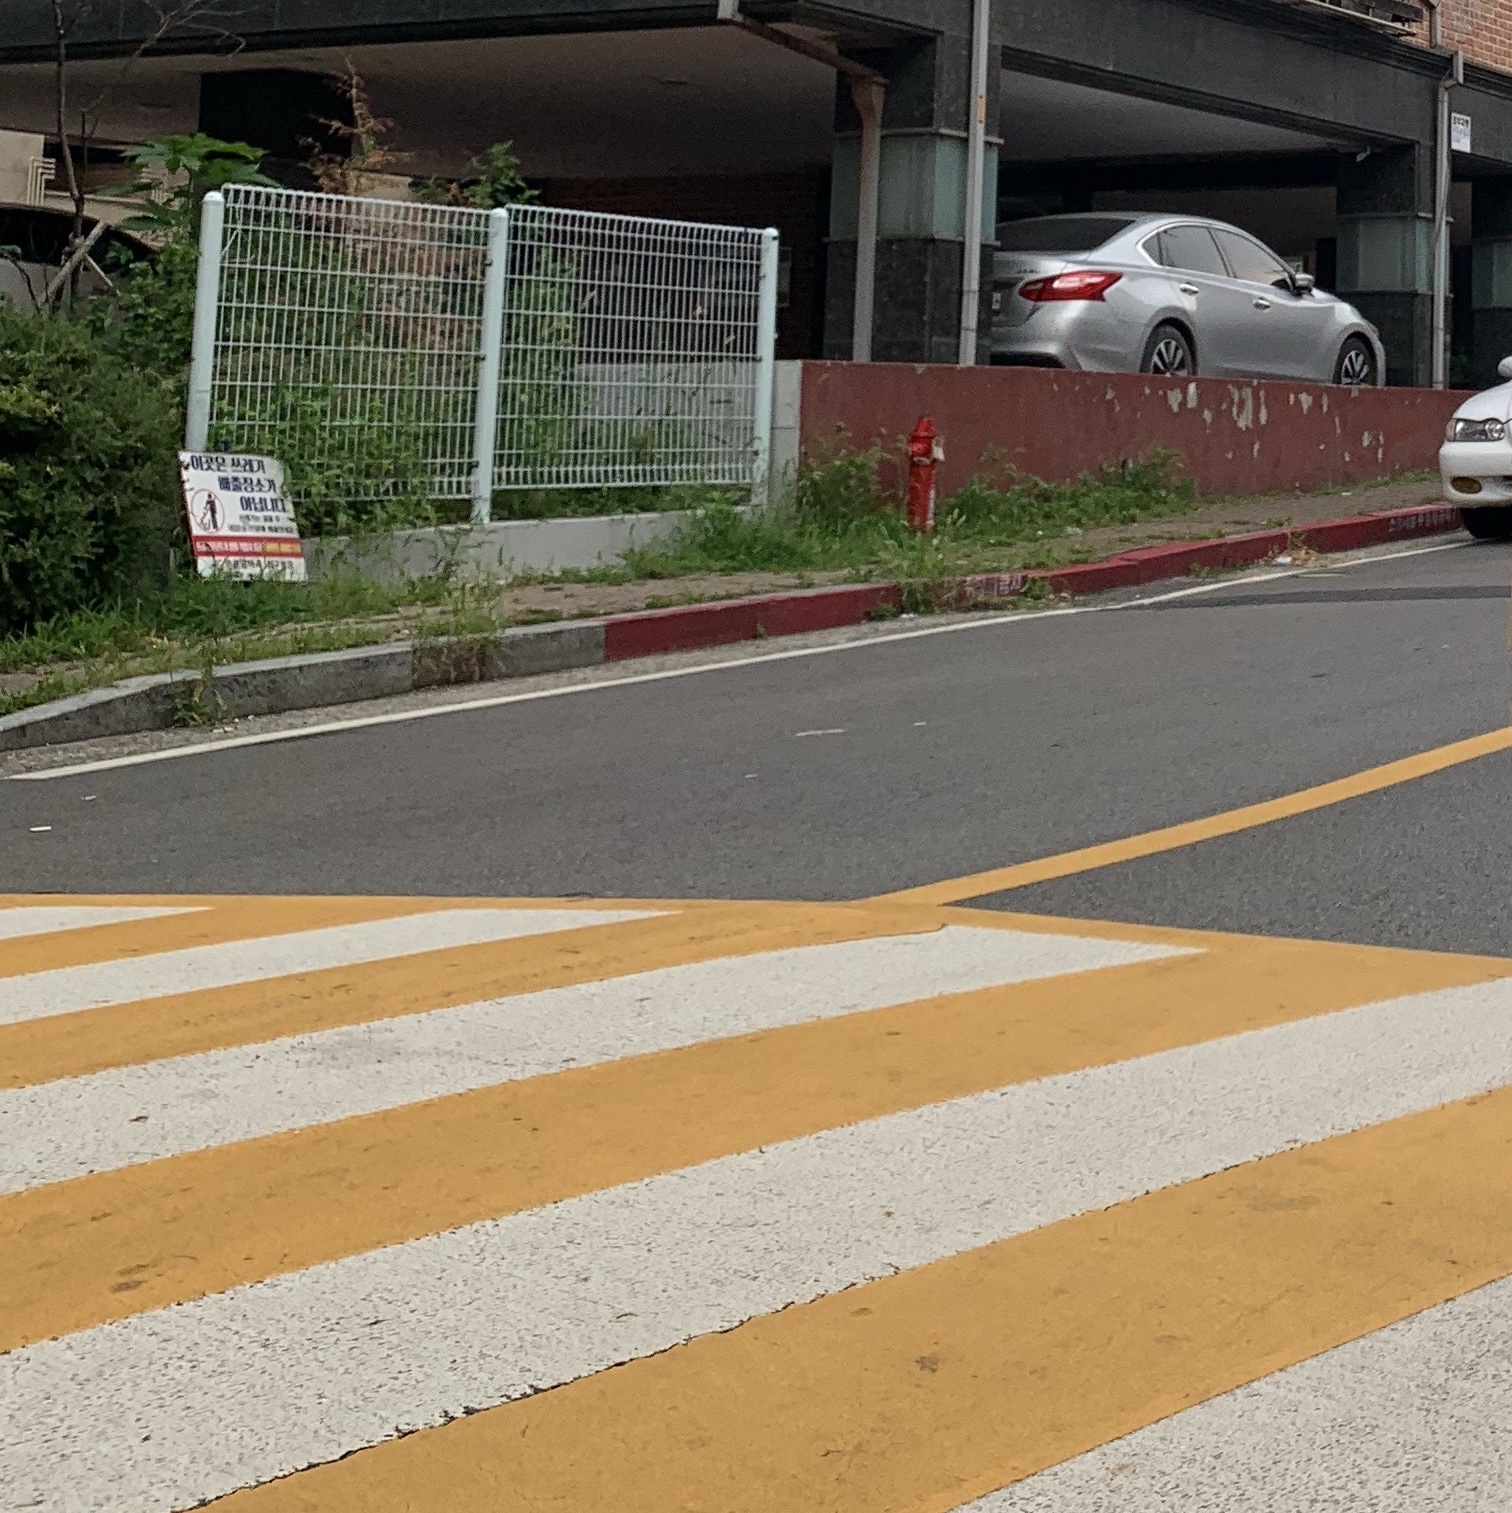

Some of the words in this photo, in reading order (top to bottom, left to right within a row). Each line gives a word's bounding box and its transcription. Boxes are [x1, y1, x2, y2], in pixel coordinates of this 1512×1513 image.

[190, 455, 227, 472] 이곳은
[231, 457, 266, 473] 쓰레기
[240, 496, 287, 512] 아닙니다
